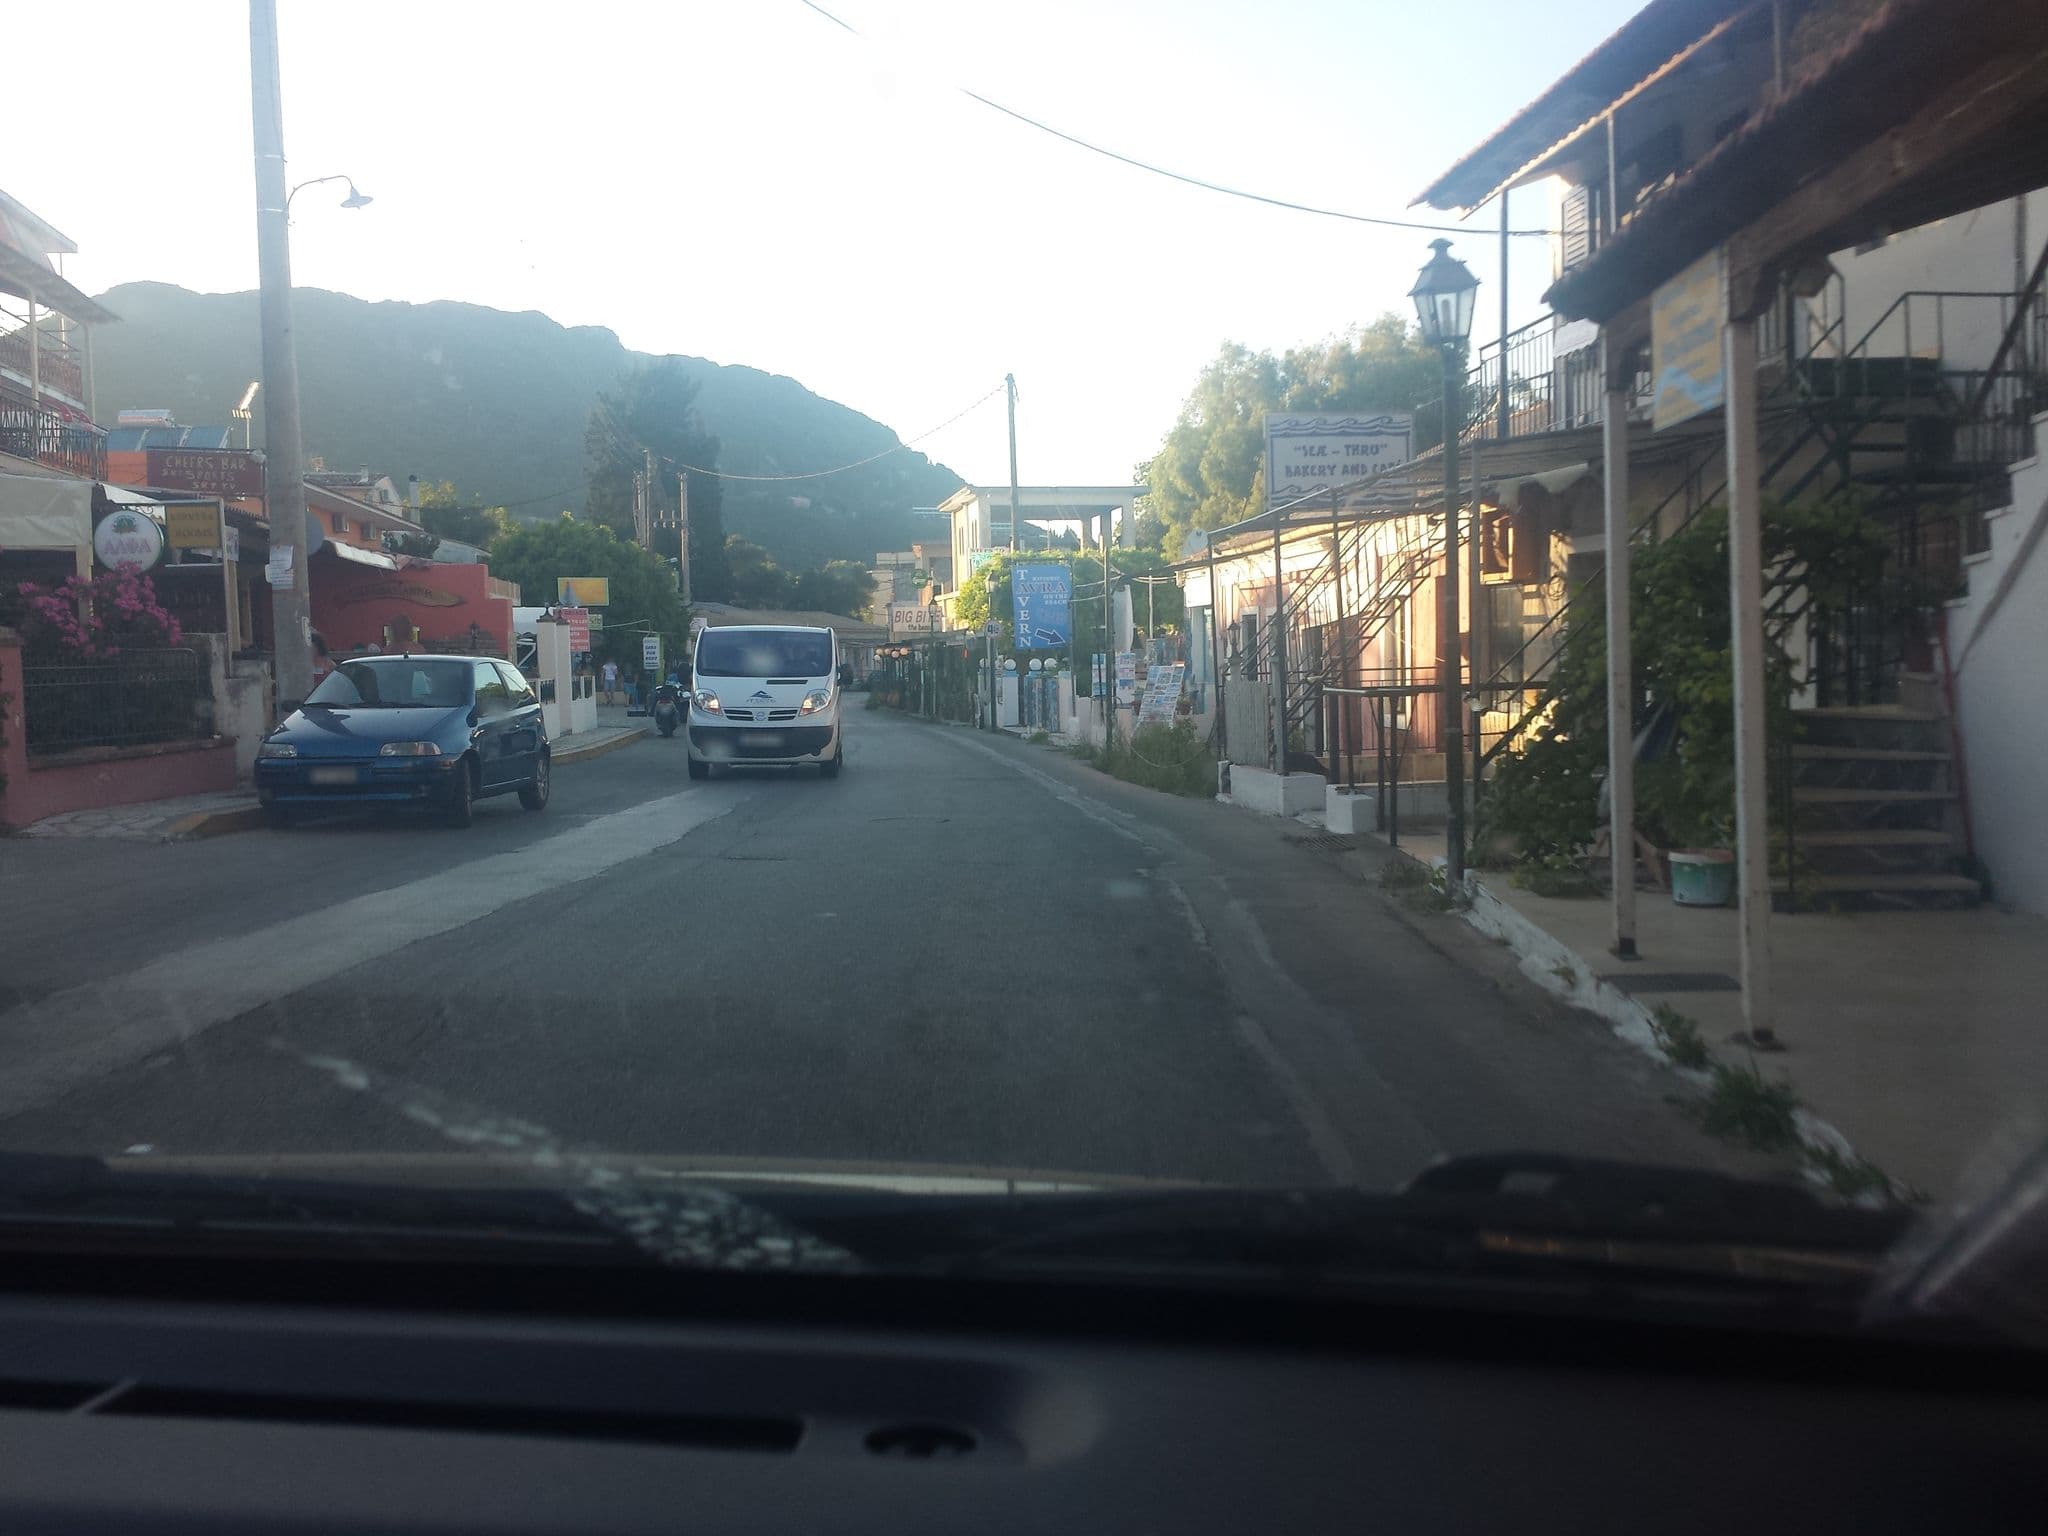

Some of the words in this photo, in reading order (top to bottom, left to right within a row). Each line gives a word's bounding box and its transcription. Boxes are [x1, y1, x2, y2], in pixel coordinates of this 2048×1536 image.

[221, 456, 246, 471] BAR
[1285, 463, 1337, 478] BAKERY
[1341, 463, 1368, 476] AND
[1017, 581, 1067, 593] AVRA
[895, 610, 913, 624] BIG
